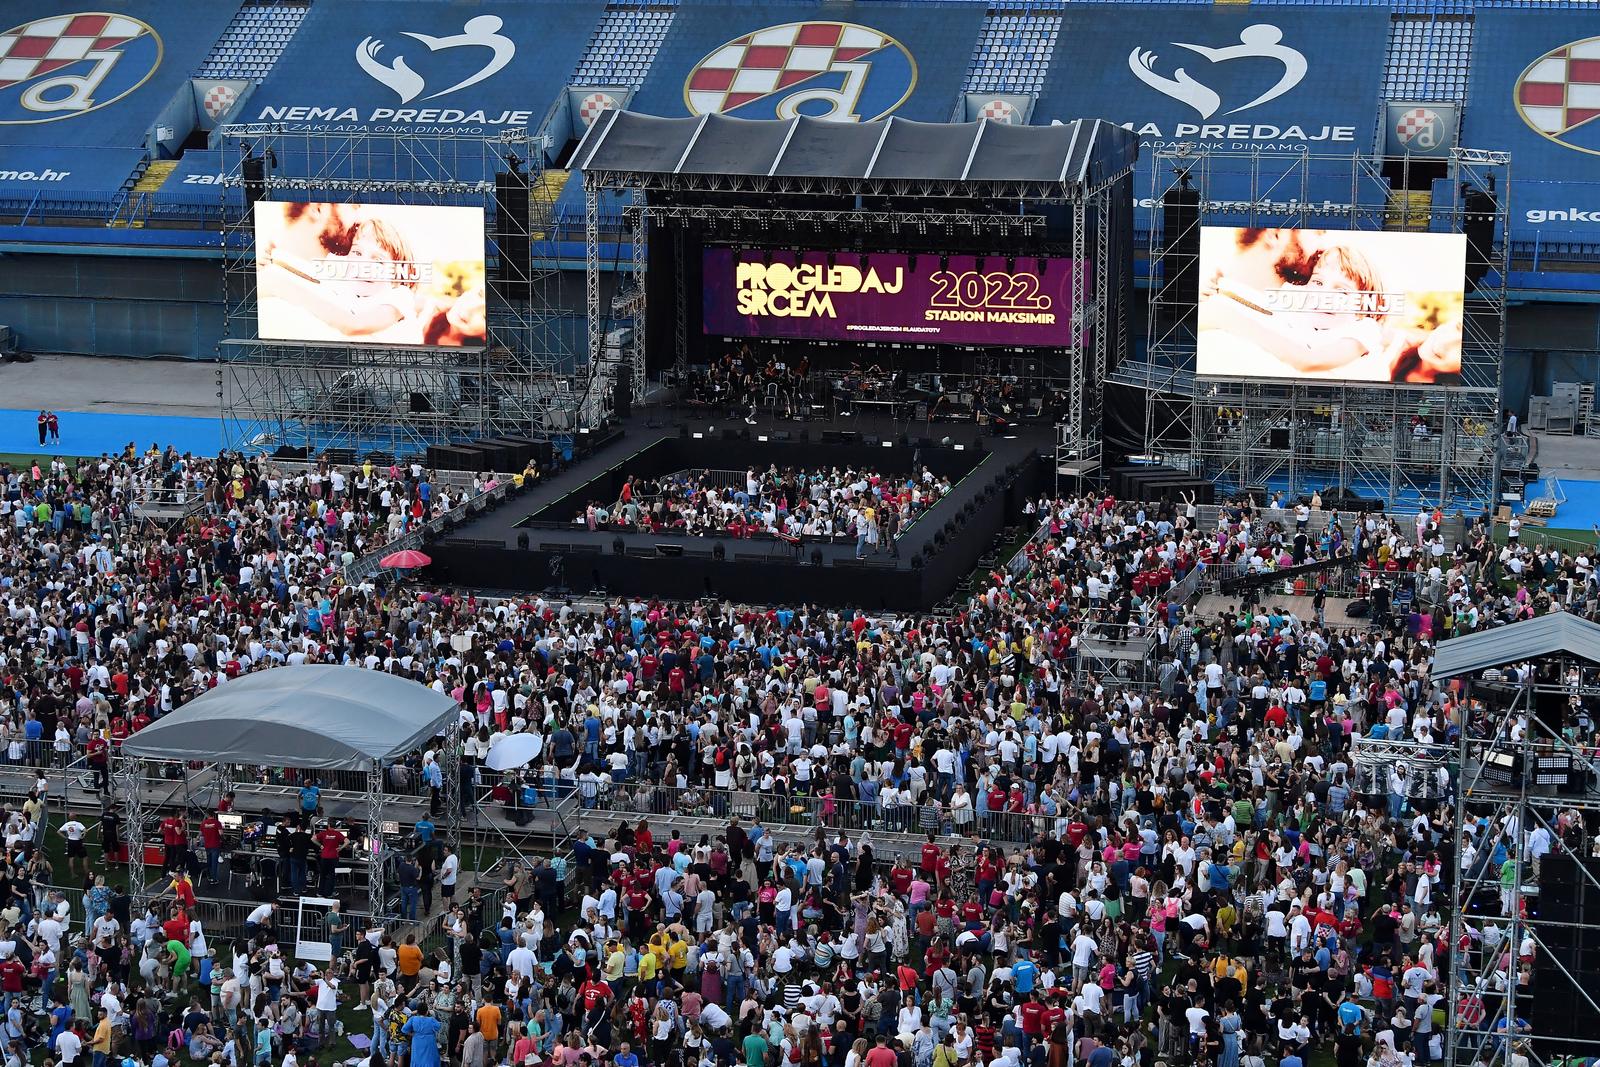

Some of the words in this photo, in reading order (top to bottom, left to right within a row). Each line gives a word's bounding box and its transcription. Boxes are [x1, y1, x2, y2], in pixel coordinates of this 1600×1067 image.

[258, 106, 358, 121] NEMA
[369, 108, 532, 125] PREDAJE
[374, 125, 408, 133] GNK
[414, 125, 482, 134] DINAMO
[1175, 123, 1356, 141] PREDAJE
[736, 263, 904, 293] PROGLEDAJ
[929, 271, 1051, 309] 2022.
[736, 289, 837, 318] SRCEM
[925, 310, 984, 322] STADION
[987, 312, 1055, 324] MAKSIMIR
